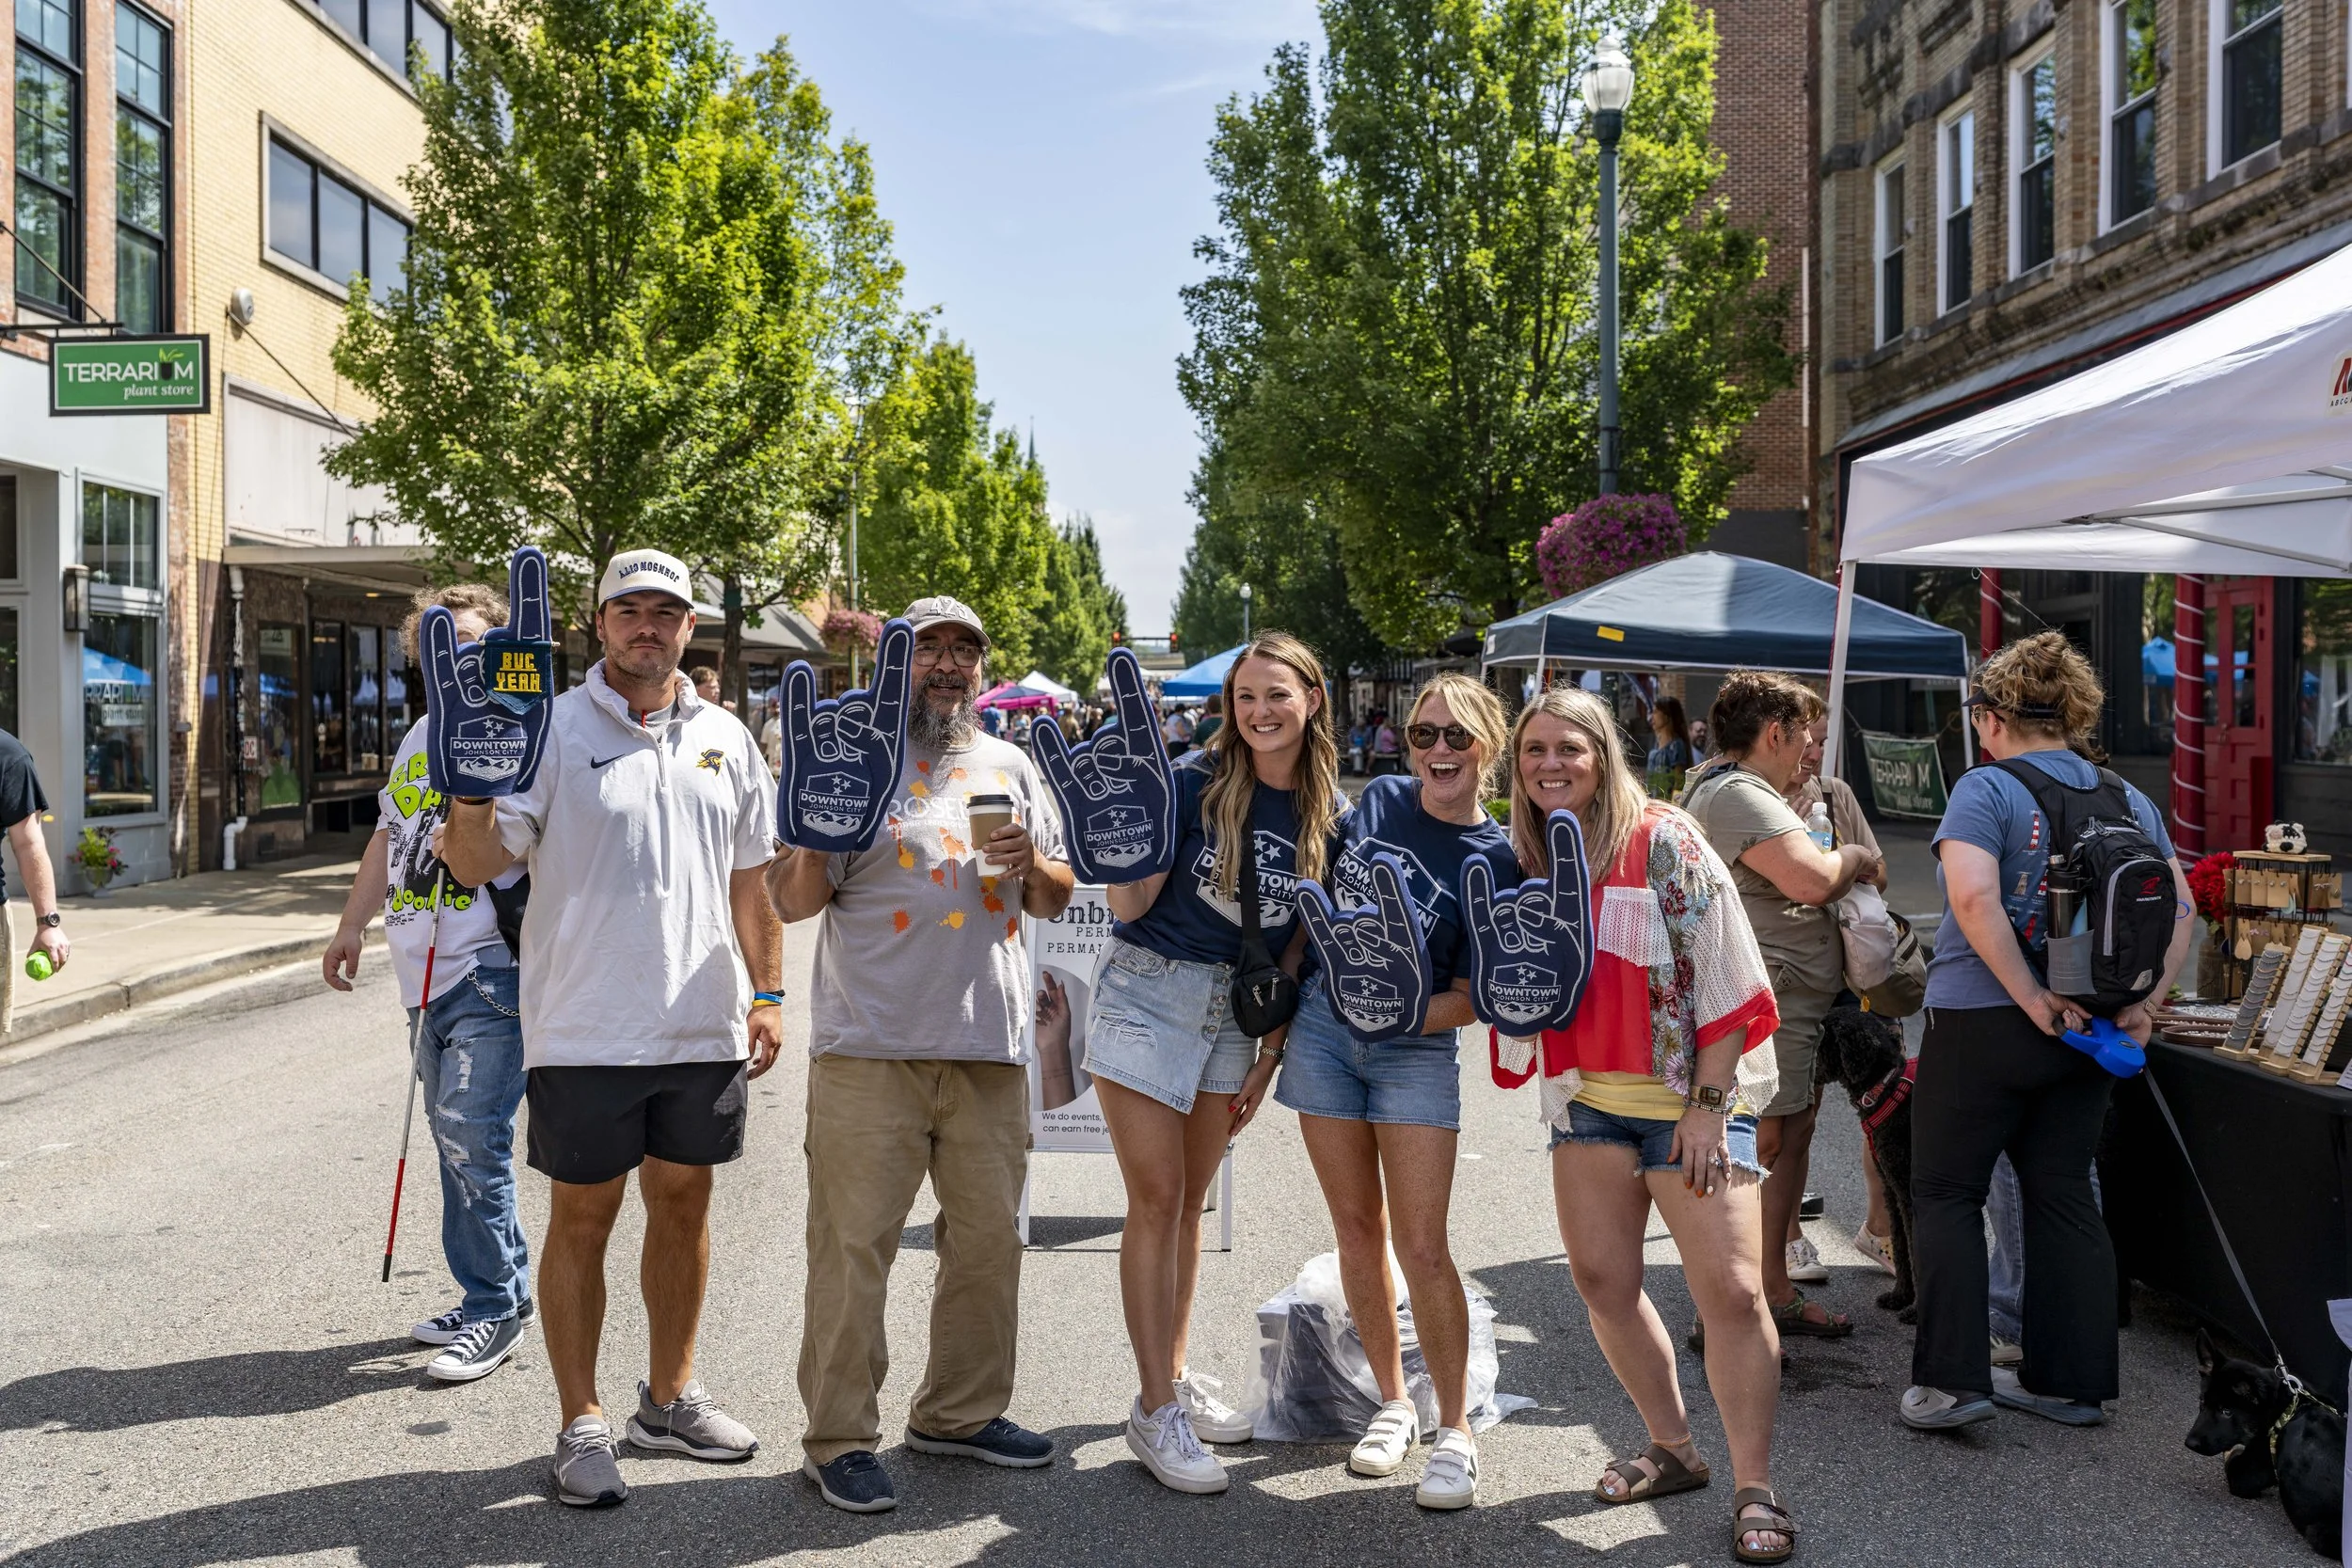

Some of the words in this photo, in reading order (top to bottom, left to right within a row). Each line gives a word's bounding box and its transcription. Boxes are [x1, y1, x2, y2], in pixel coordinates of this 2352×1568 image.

[123, 383, 157, 401] plant
[161, 385, 194, 396] store
[618, 562, 640, 579] CITY
[640, 561, 680, 583] JOHNSON
[502, 652, 535, 670] BUC
[495, 672, 541, 691] YEAH
[453, 740, 527, 750] DOWNTOWN
[801, 792, 869, 808] DOWNTOWN
[809, 803, 844, 812] JOHNSON
[1086, 822, 1152, 842] DOWNTOWN
[1097, 836, 1129, 847] JOHNSON
[1130, 832, 1145, 841] CITY
[1270, 887, 1295, 900] CITY
[1489, 983, 1559, 997] DOWNTOWN
[1342, 993, 1402, 1008] OWNTOWN
[1041, 1112, 1056, 1120] We
[1057, 1112, 1070, 1120] do
[1071, 1113, 1102, 1122] events,
[1083, 1125, 1100, 1133] free
[1102, 1126, 1110, 1135] je
